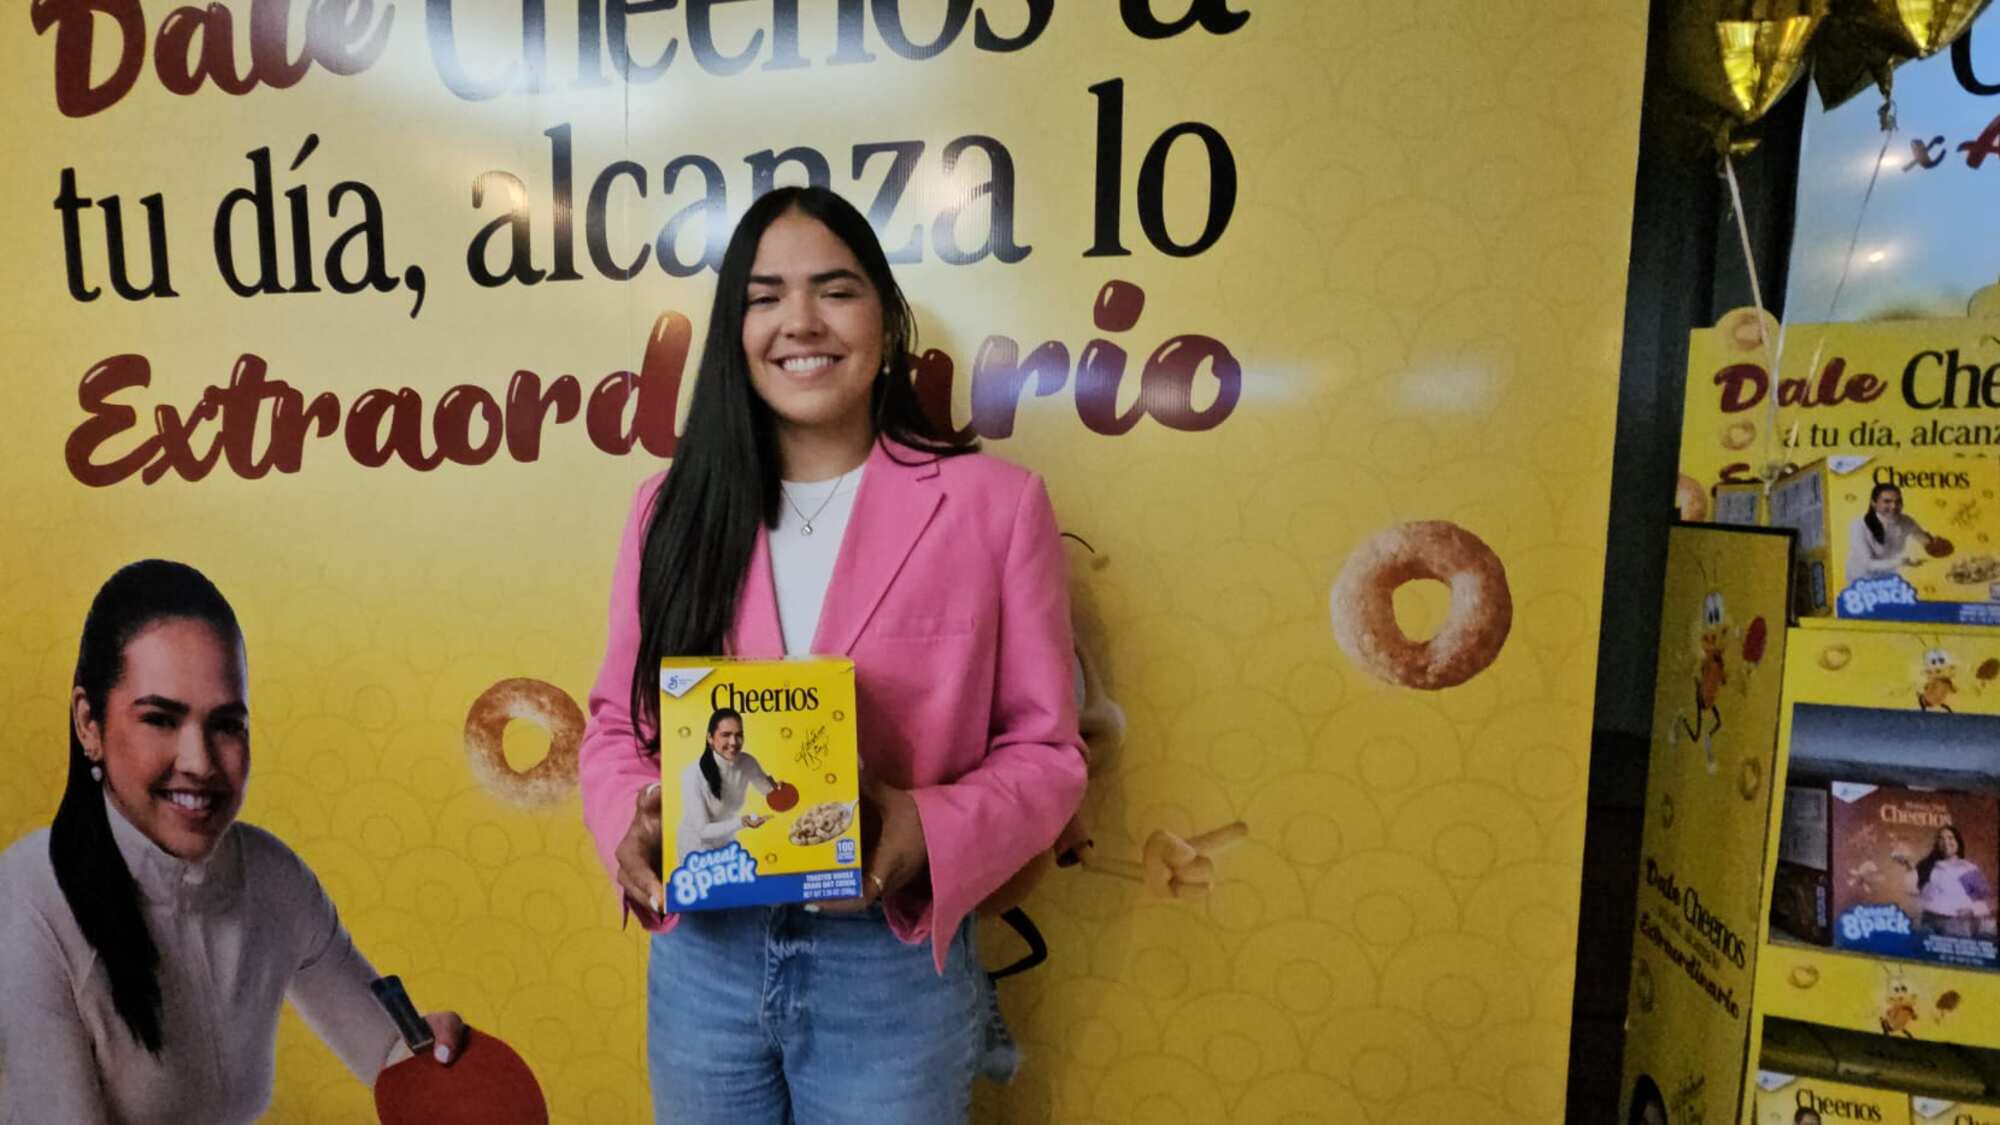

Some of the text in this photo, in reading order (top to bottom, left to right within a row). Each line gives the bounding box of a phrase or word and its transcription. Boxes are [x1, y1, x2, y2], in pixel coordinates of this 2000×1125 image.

[30, 0, 395, 118] Dale
[53, 167, 180, 302] tu
[212, 133, 426, 318] día,
[1082, 77, 1237, 257] lo
[1713, 356, 1888, 413] Dale
[1811, 424, 1838, 447] tu
[1850, 419, 1901, 449] día,
[1873, 465, 1970, 489] Cheerios
[711, 682, 819, 713] Cheerios
[688, 842, 738, 872] Cereal
[673, 850, 756, 905] 8pack
[1796, 1088, 1881, 1123] Cheerios
